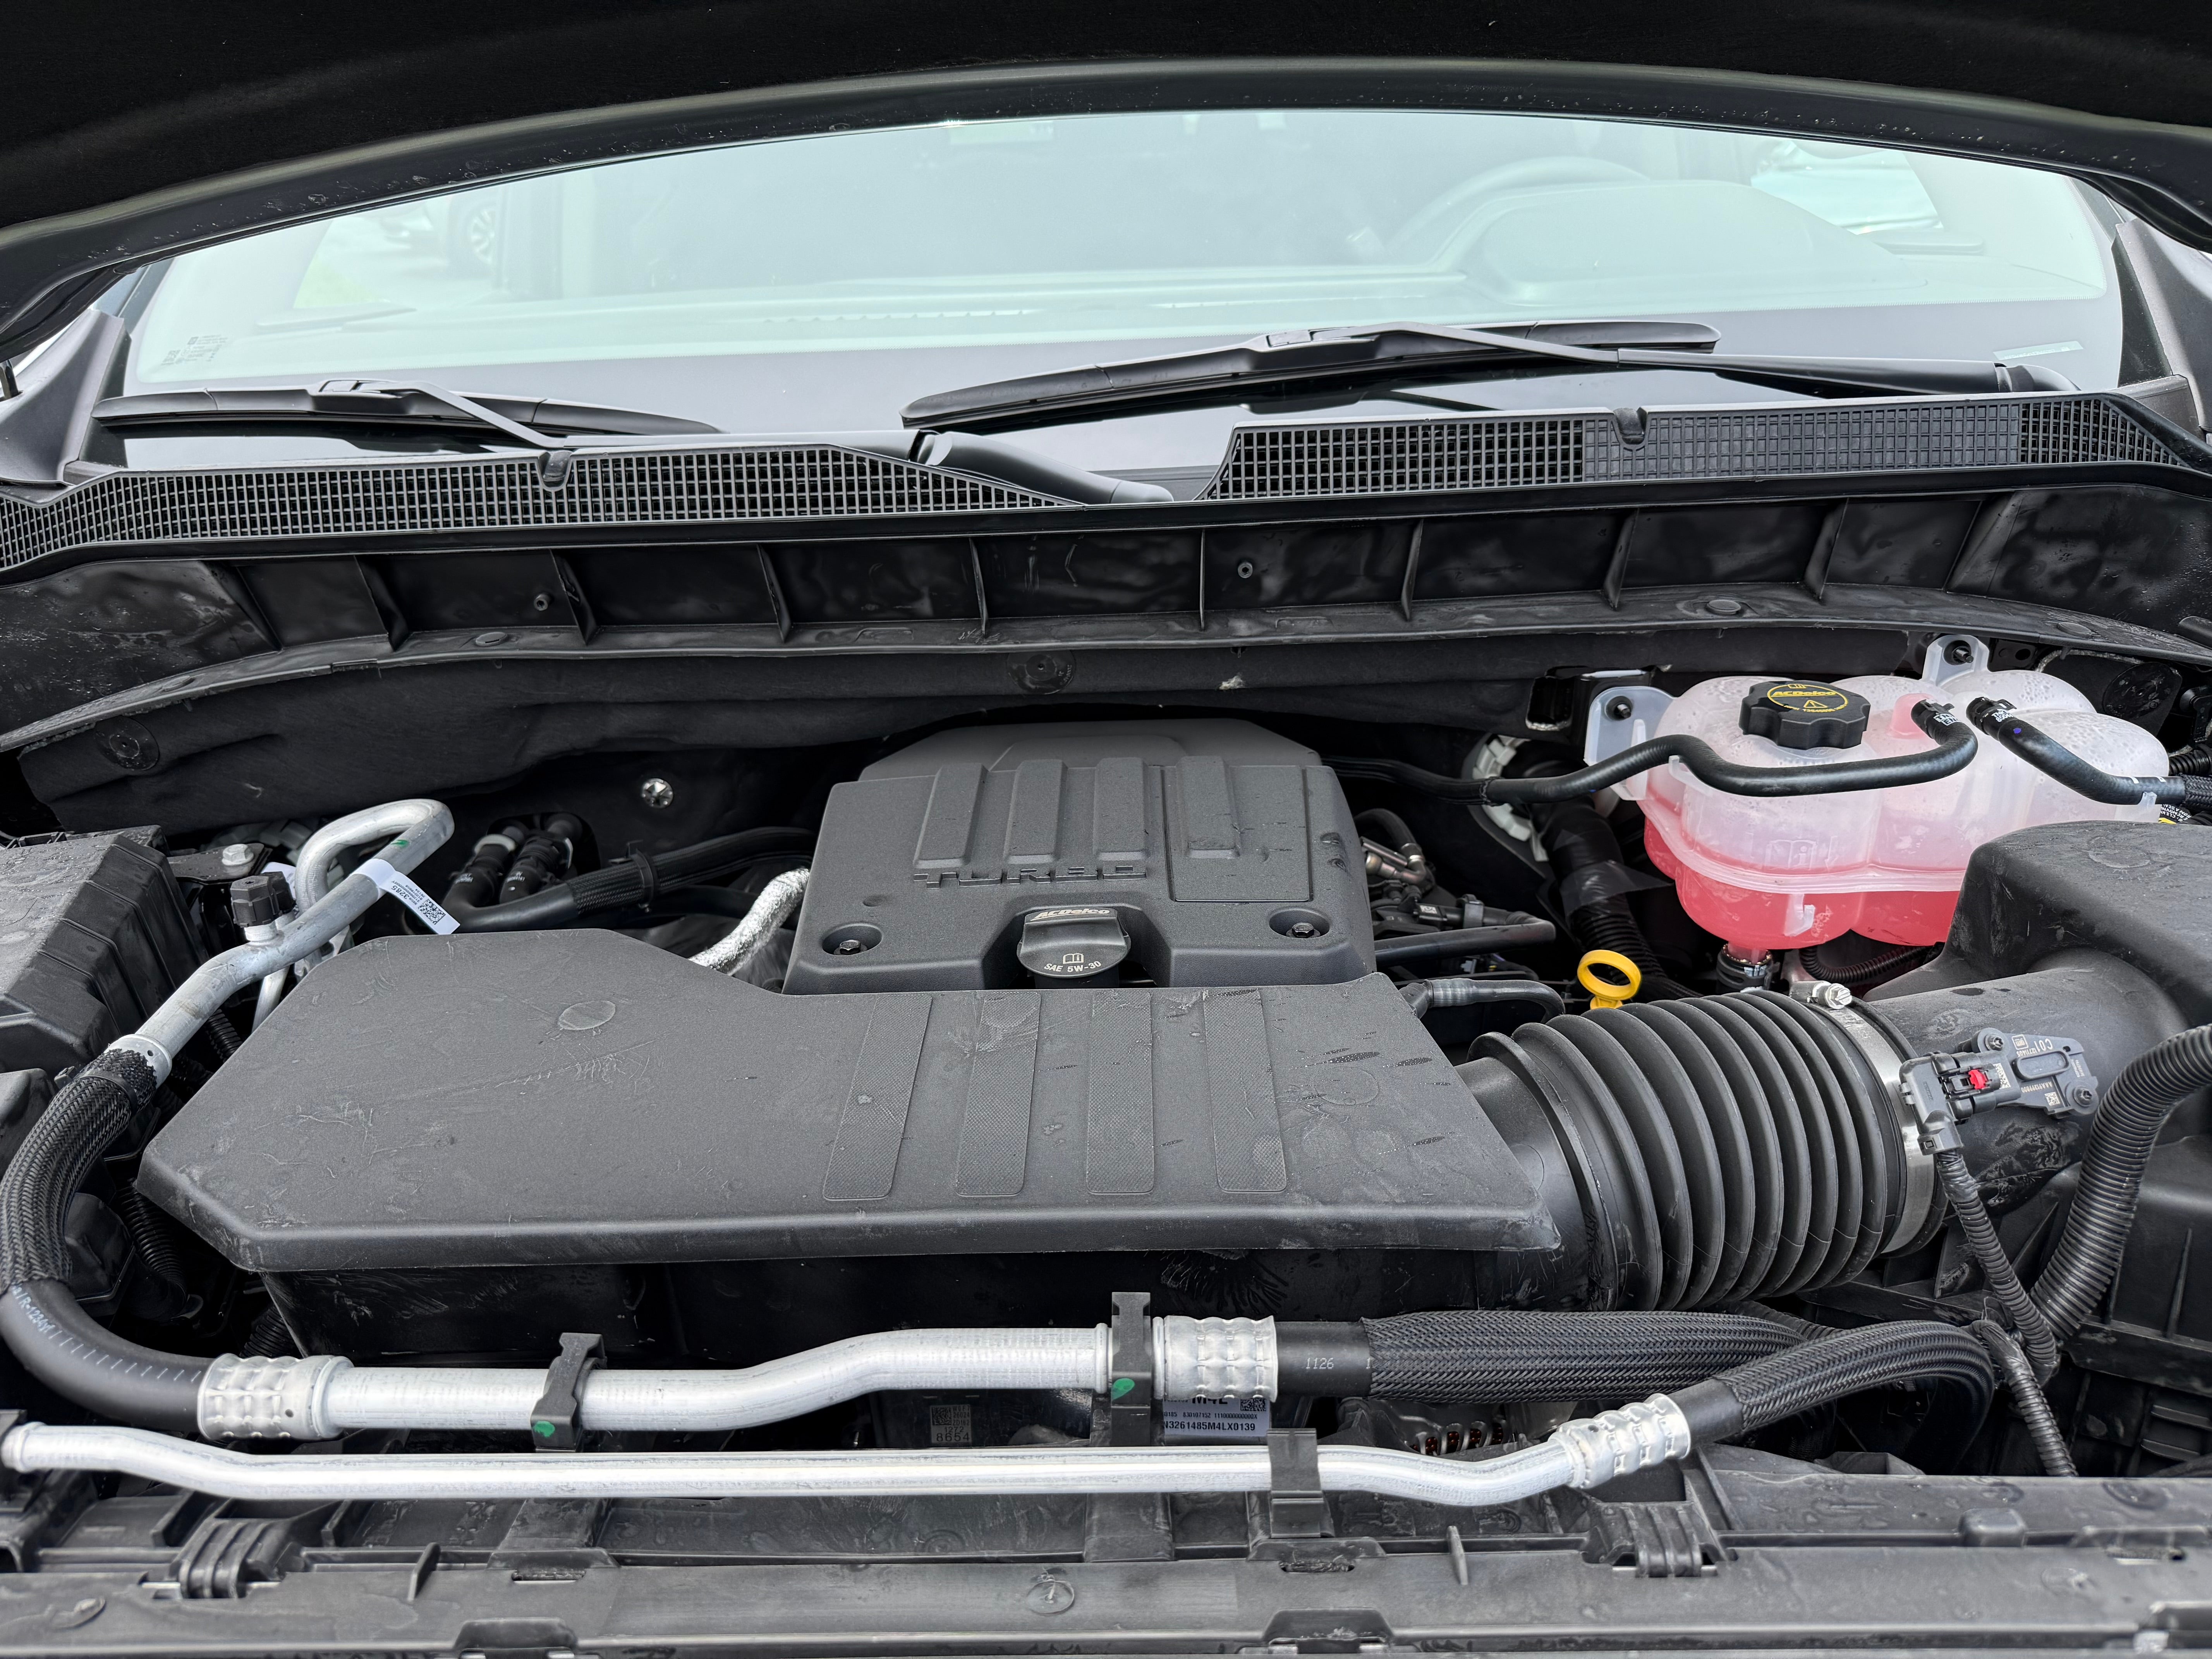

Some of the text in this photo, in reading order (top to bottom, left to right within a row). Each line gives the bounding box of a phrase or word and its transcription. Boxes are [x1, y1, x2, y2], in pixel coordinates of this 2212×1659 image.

[913, 864, 1147, 889] TURBO
[1034, 908, 1110, 919] ACDelco
[1044, 961, 1101, 972] SAE 5W-30
[1306, 1357, 1334, 1369] 1126
[936, 1432, 970, 1441] 8654
